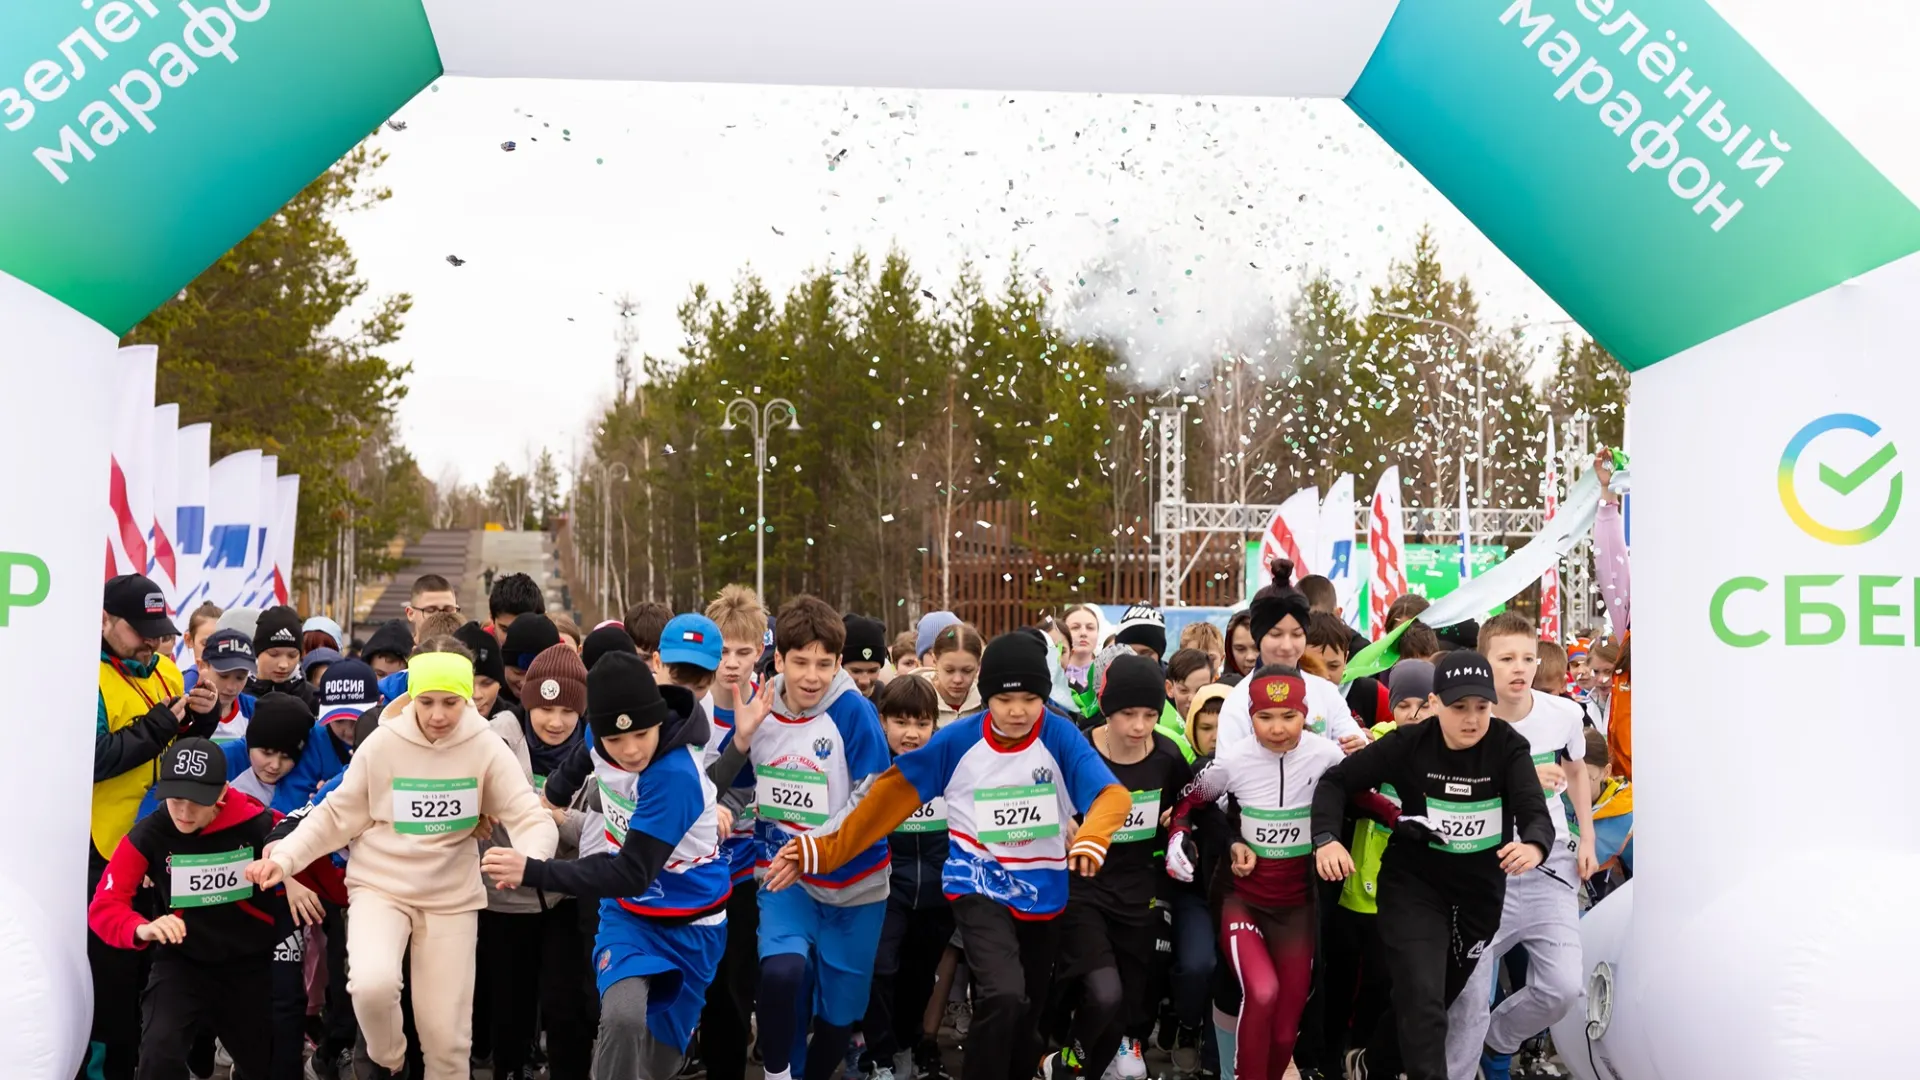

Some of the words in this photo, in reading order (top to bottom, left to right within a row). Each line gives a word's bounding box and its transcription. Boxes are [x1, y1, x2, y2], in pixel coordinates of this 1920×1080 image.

[0, 0, 160, 131] зелё
[1498, 0, 1744, 233] марафон
[1122, 606, 1163, 620] NIKE
[1709, 574, 1920, 648] СБЕ
[217, 638, 252, 656] FILA
[1445, 666, 1489, 679] YAMAL
[325, 679, 364, 694] РОССИЯ
[173, 749, 208, 777] 35
[772, 787, 813, 808] 5226
[411, 799, 462, 818] 5223
[783, 811, 800, 820] 1000
[910, 802, 934, 818] 36
[994, 806, 1041, 826] 5274
[608, 804, 630, 832] 523
[424, 824, 446, 832] 1000
[1007, 830, 1027, 839] 1000
[1256, 827, 1300, 844] 5279
[1442, 819, 1486, 837] 5267
[190, 871, 238, 891] 5206
[201, 895, 221, 904] 1000
